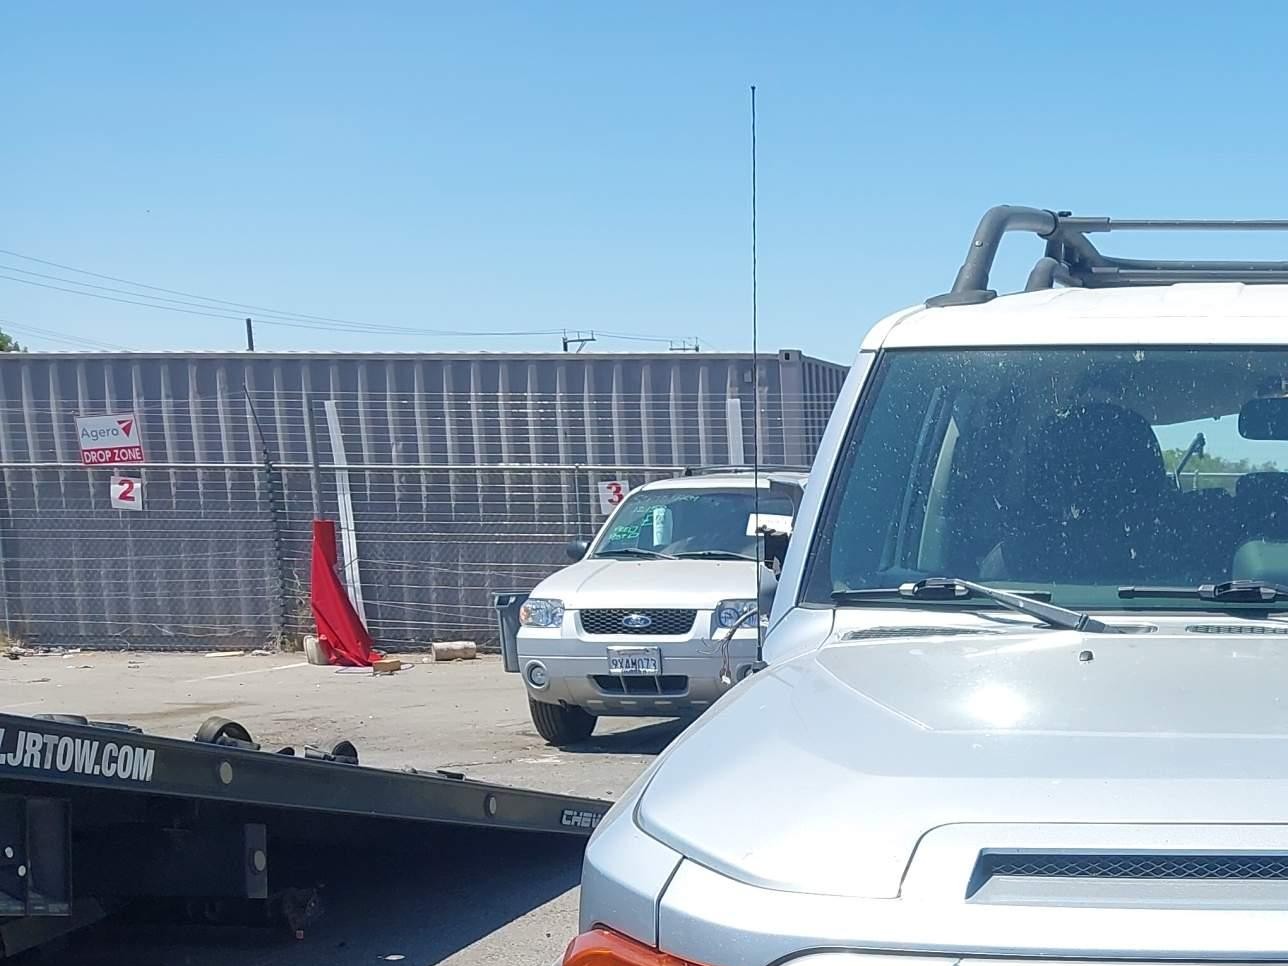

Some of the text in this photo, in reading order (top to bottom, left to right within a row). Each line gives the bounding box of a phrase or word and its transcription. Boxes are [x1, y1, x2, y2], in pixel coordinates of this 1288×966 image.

[81, 427, 120, 441] Agero
[83, 447, 142, 464] DROP ZONE
[118, 479, 136, 502] 2
[607, 482, 625, 505] 3
[0, 728, 155, 782] .JRTOW.COM
